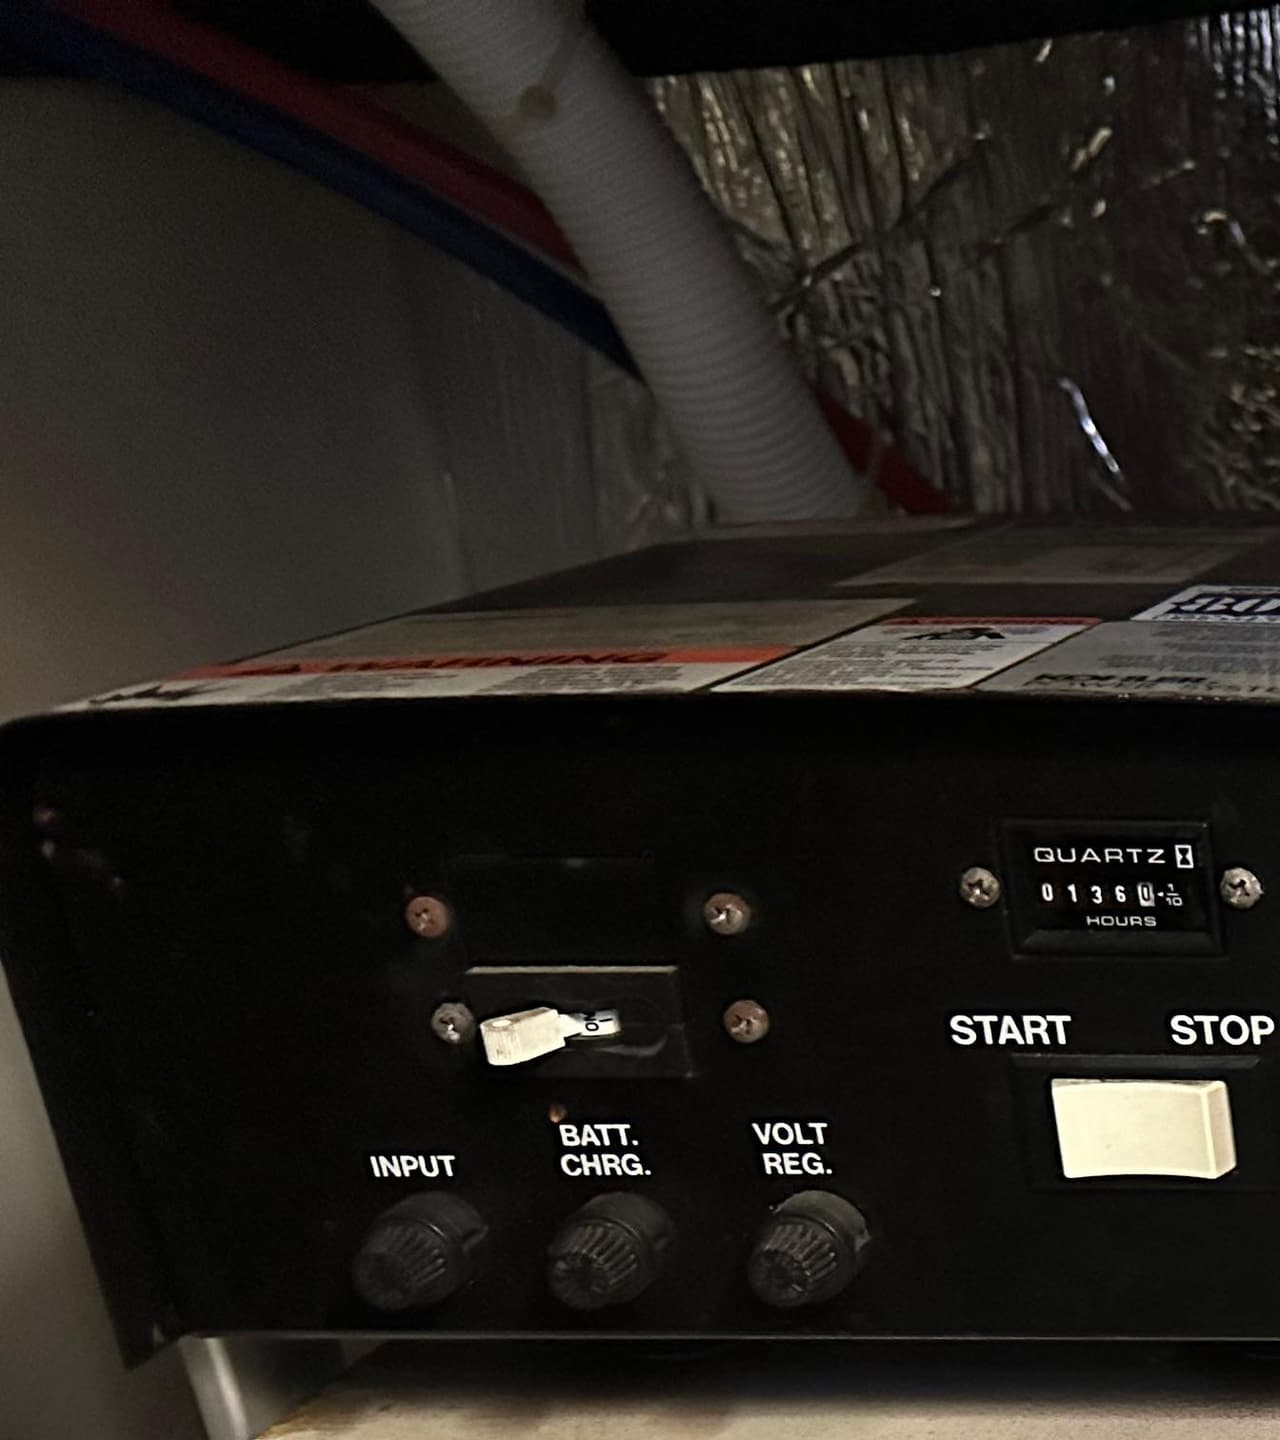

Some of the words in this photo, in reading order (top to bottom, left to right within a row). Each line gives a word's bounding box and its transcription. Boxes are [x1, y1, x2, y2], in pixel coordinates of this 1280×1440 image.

[1033, 847, 1166, 863] QUARTZ
[1086, 915, 1157, 927] HOURS
[949, 1014, 1072, 1046] START
[1170, 1014, 1275, 1046] STOP
[558, 1123, 640, 1147] BATT.
[751, 1121, 829, 1146] VOLT
[369, 1154, 456, 1179] INPUT
[560, 1153, 652, 1177] CHRG.
[762, 1152, 834, 1176] REG.
